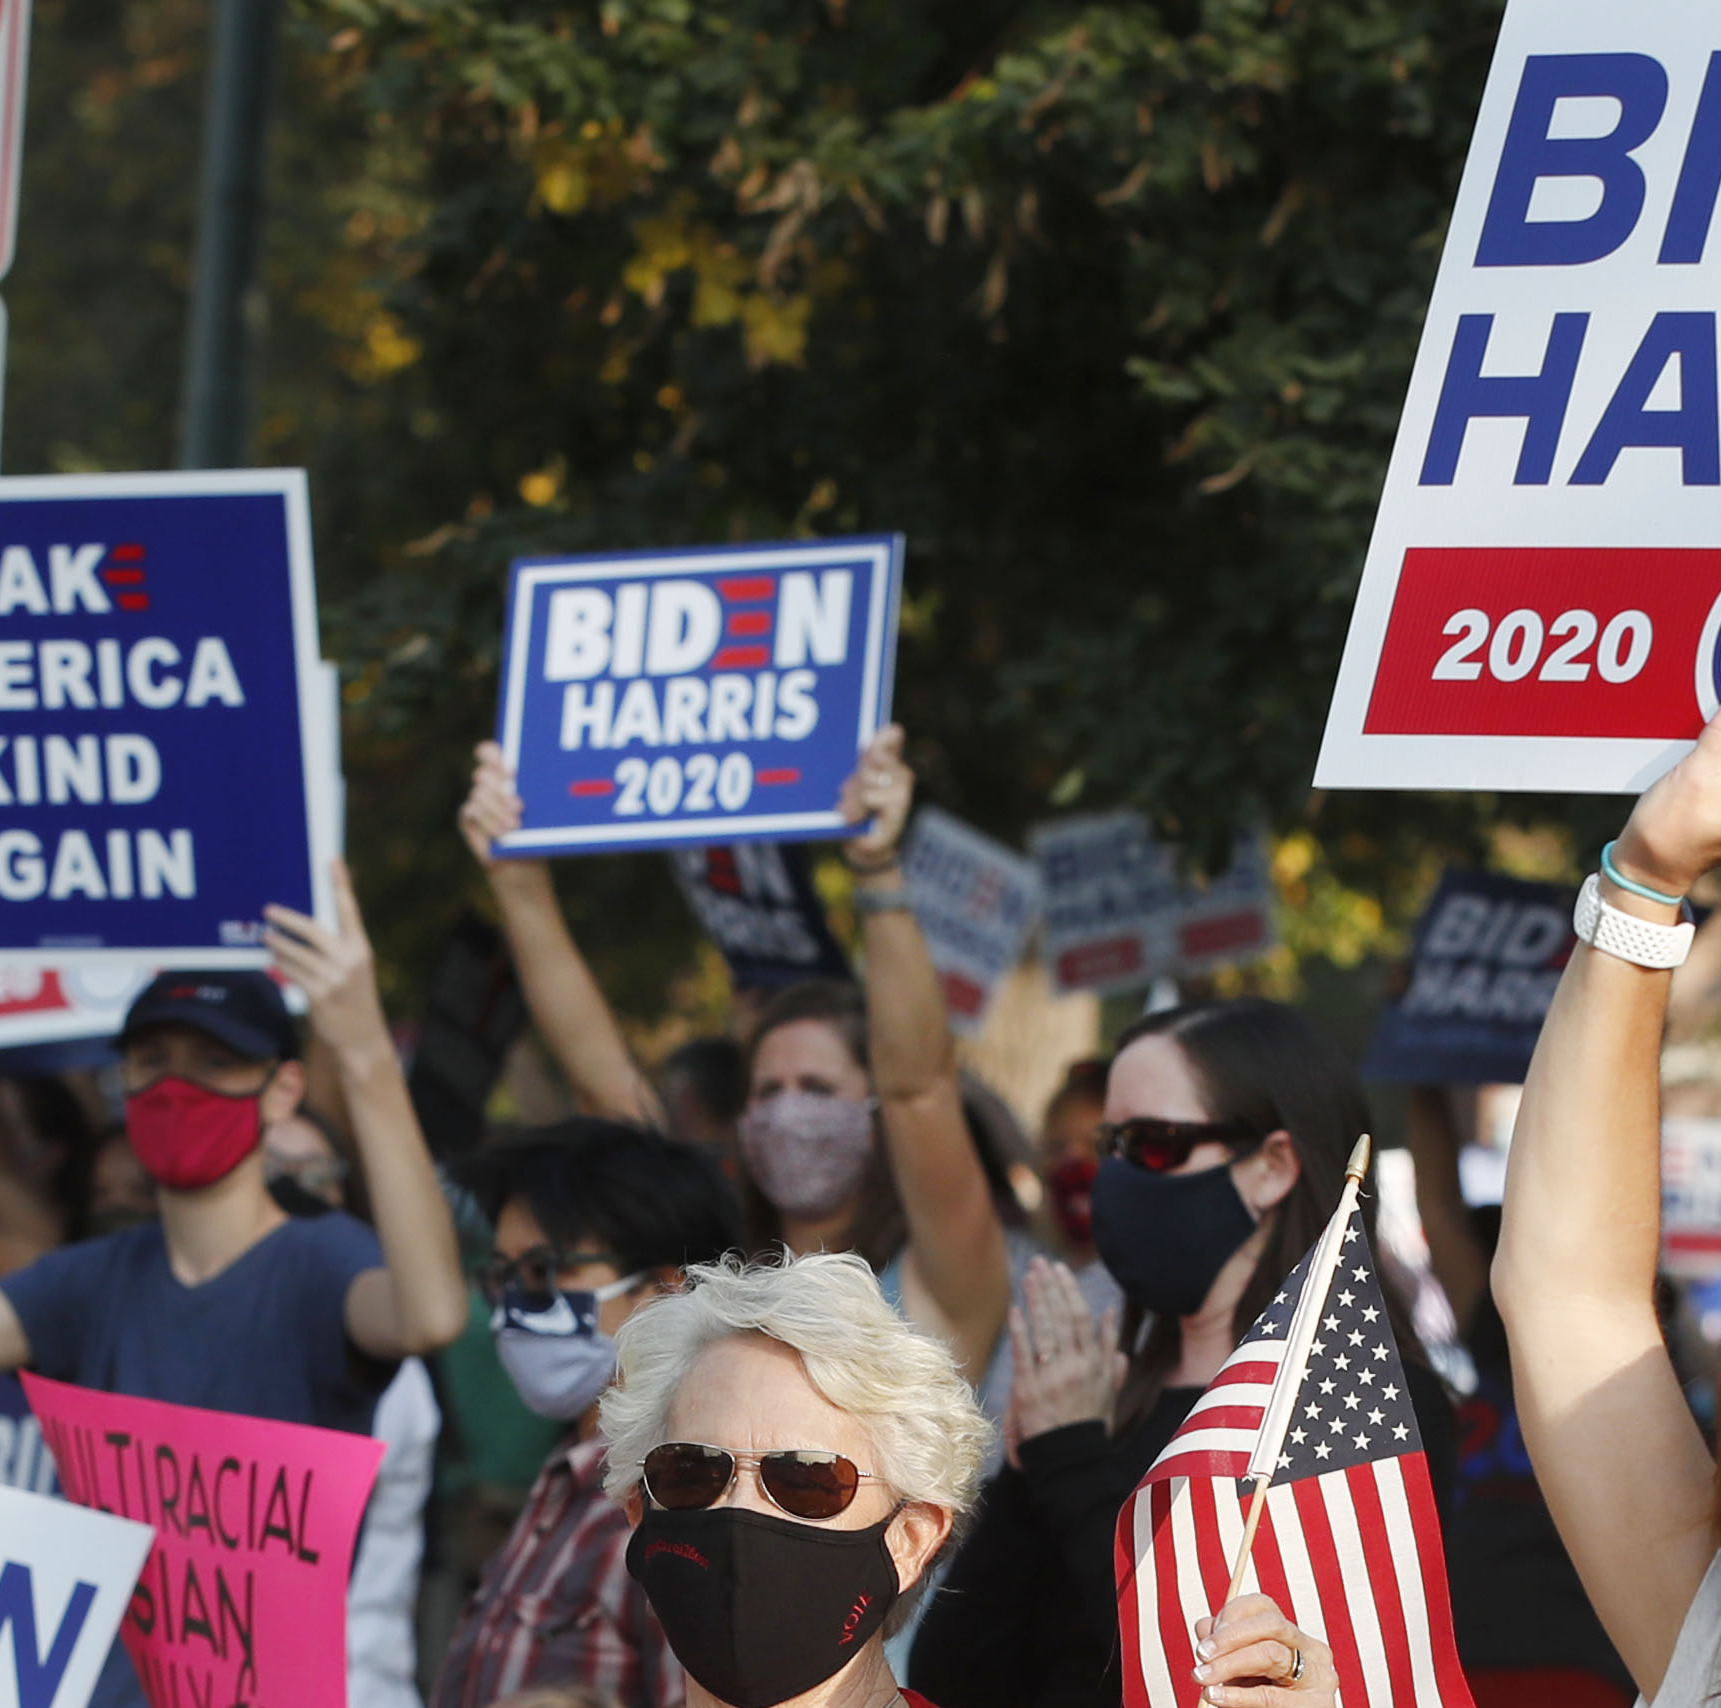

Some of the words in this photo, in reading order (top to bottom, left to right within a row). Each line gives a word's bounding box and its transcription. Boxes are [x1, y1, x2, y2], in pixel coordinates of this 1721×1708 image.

[544, 567, 854, 682] BIDEN
[1430, 607, 1654, 683] 2020
[560, 668, 820, 750] HARRIS
[613, 750, 754, 817] 2020
